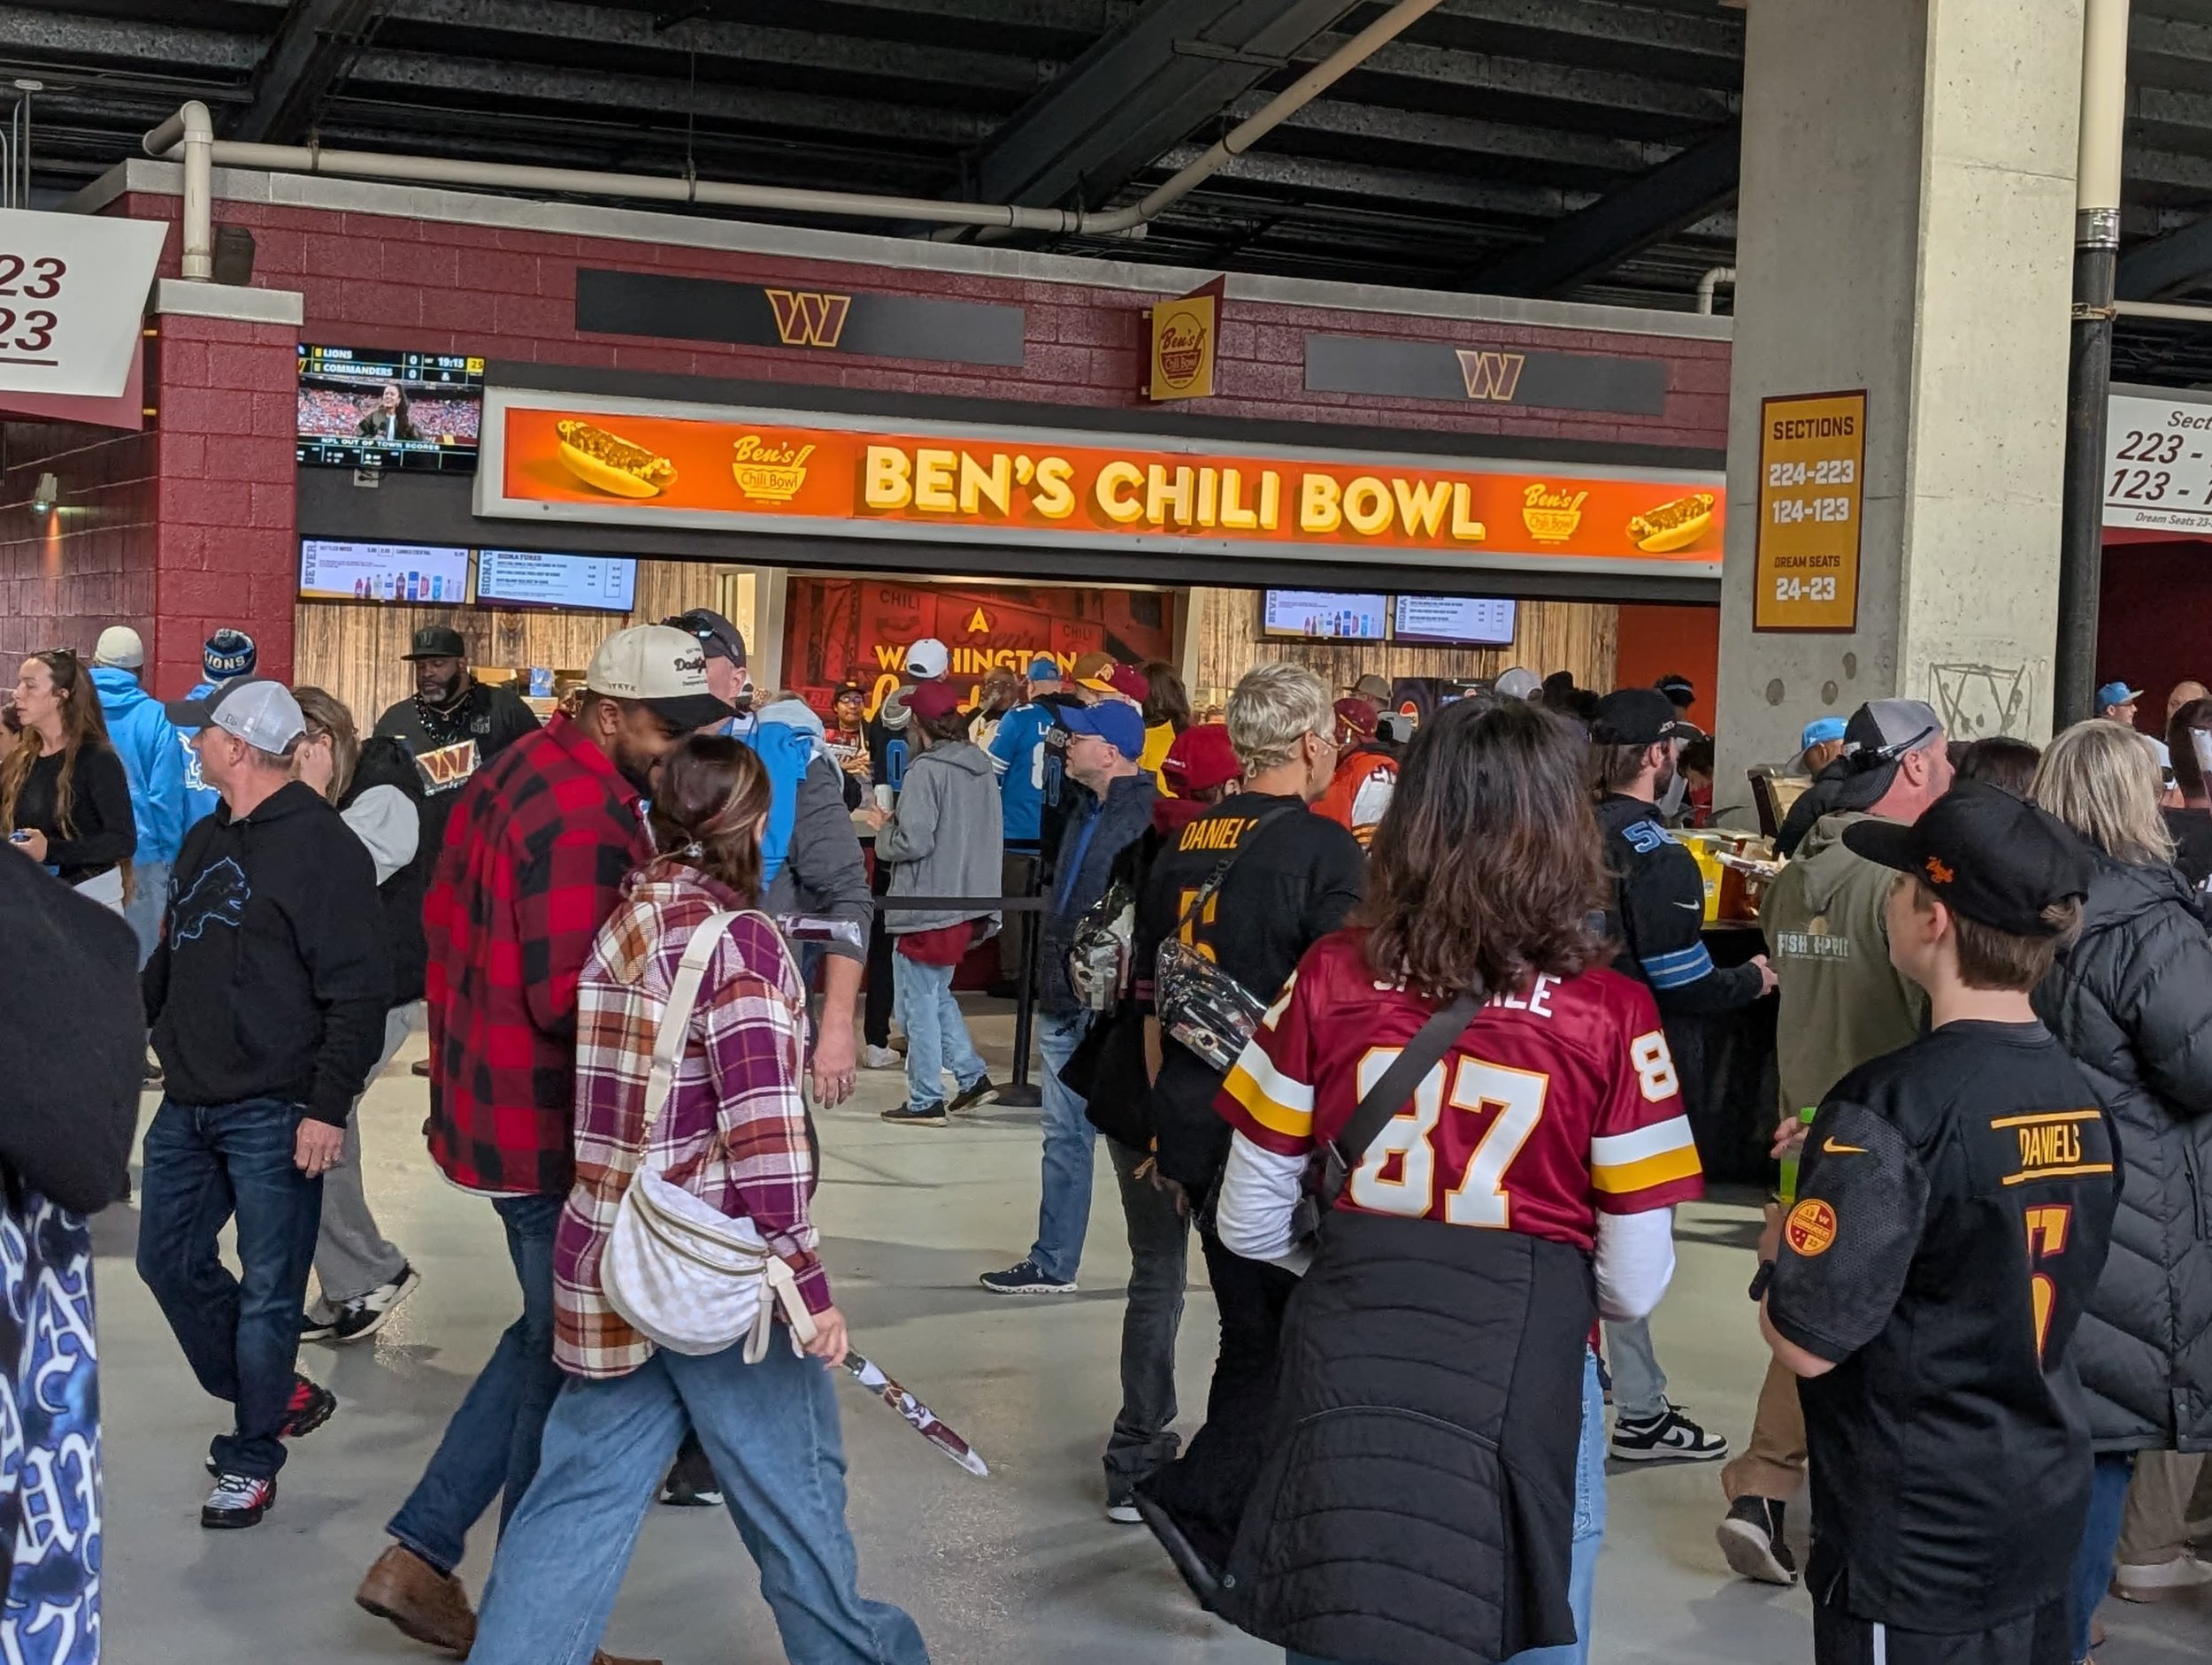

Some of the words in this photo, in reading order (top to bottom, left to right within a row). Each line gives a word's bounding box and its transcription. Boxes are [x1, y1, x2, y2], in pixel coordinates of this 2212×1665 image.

[1161, 327, 1195, 350] Ben's
[323, 349, 352, 359] LIONS
[323, 363, 393, 377] COMMANDERS
[1773, 417, 1854, 440] SECTIONS
[733, 434, 795, 463] Ben's
[2116, 430, 2185, 464] 223
[769, 474, 797, 488] Bowl
[1770, 460, 1855, 487] 224-223
[2108, 468, 2171, 500] 123
[865, 445, 1076, 519] BEN'S
[1095, 461, 1279, 530] CHILI
[1301, 472, 1486, 541] BOWL
[1524, 483, 1572, 508] Ben's
[1773, 498, 1849, 524] 124-123
[2135, 512, 2167, 524] Dream
[2169, 515, 2195, 526] Seats
[1775, 556, 1807, 569] DREAM
[1809, 556, 1841, 568] SEATS
[880, 590, 920, 611] CHILI
[1776, 577, 1836, 601] 24-23
[968, 607, 989, 633] A
[1063, 625, 1093, 641] CHILI
[1179, 818, 1259, 851] DANIEL
[1777, 933, 1808, 957] FISH
[1349, 1046, 1550, 1229] 87
[2018, 1123, 2082, 1168] DANIELS
